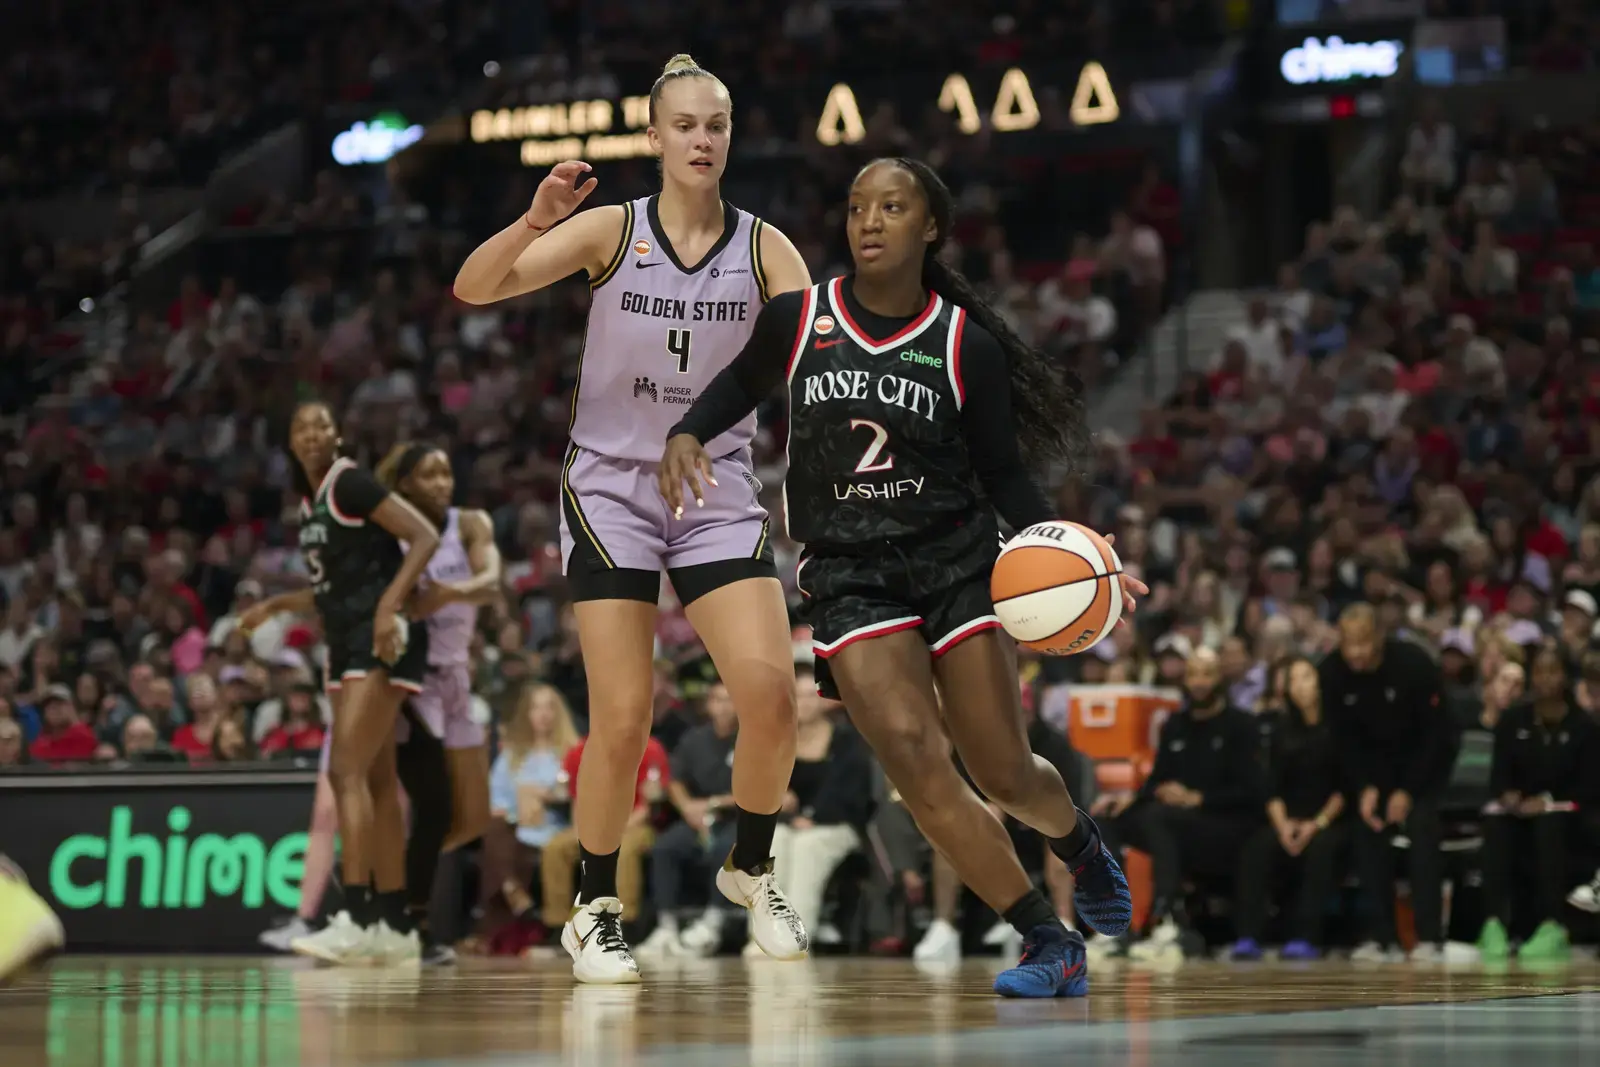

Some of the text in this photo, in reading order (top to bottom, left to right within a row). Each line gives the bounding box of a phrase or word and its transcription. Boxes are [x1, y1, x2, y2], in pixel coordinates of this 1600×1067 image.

[722, 268, 749, 278] freedom
[621, 291, 748, 321] GOLDEN STATE
[666, 327, 692, 373] 4
[900, 349, 943, 368] chime
[663, 386, 692, 396] KAISER
[803, 370, 941, 422] ROSE CITY
[850, 418, 894, 474] 2
[833, 476, 925, 500] LASHIFY
[49, 805, 311, 909] chime
